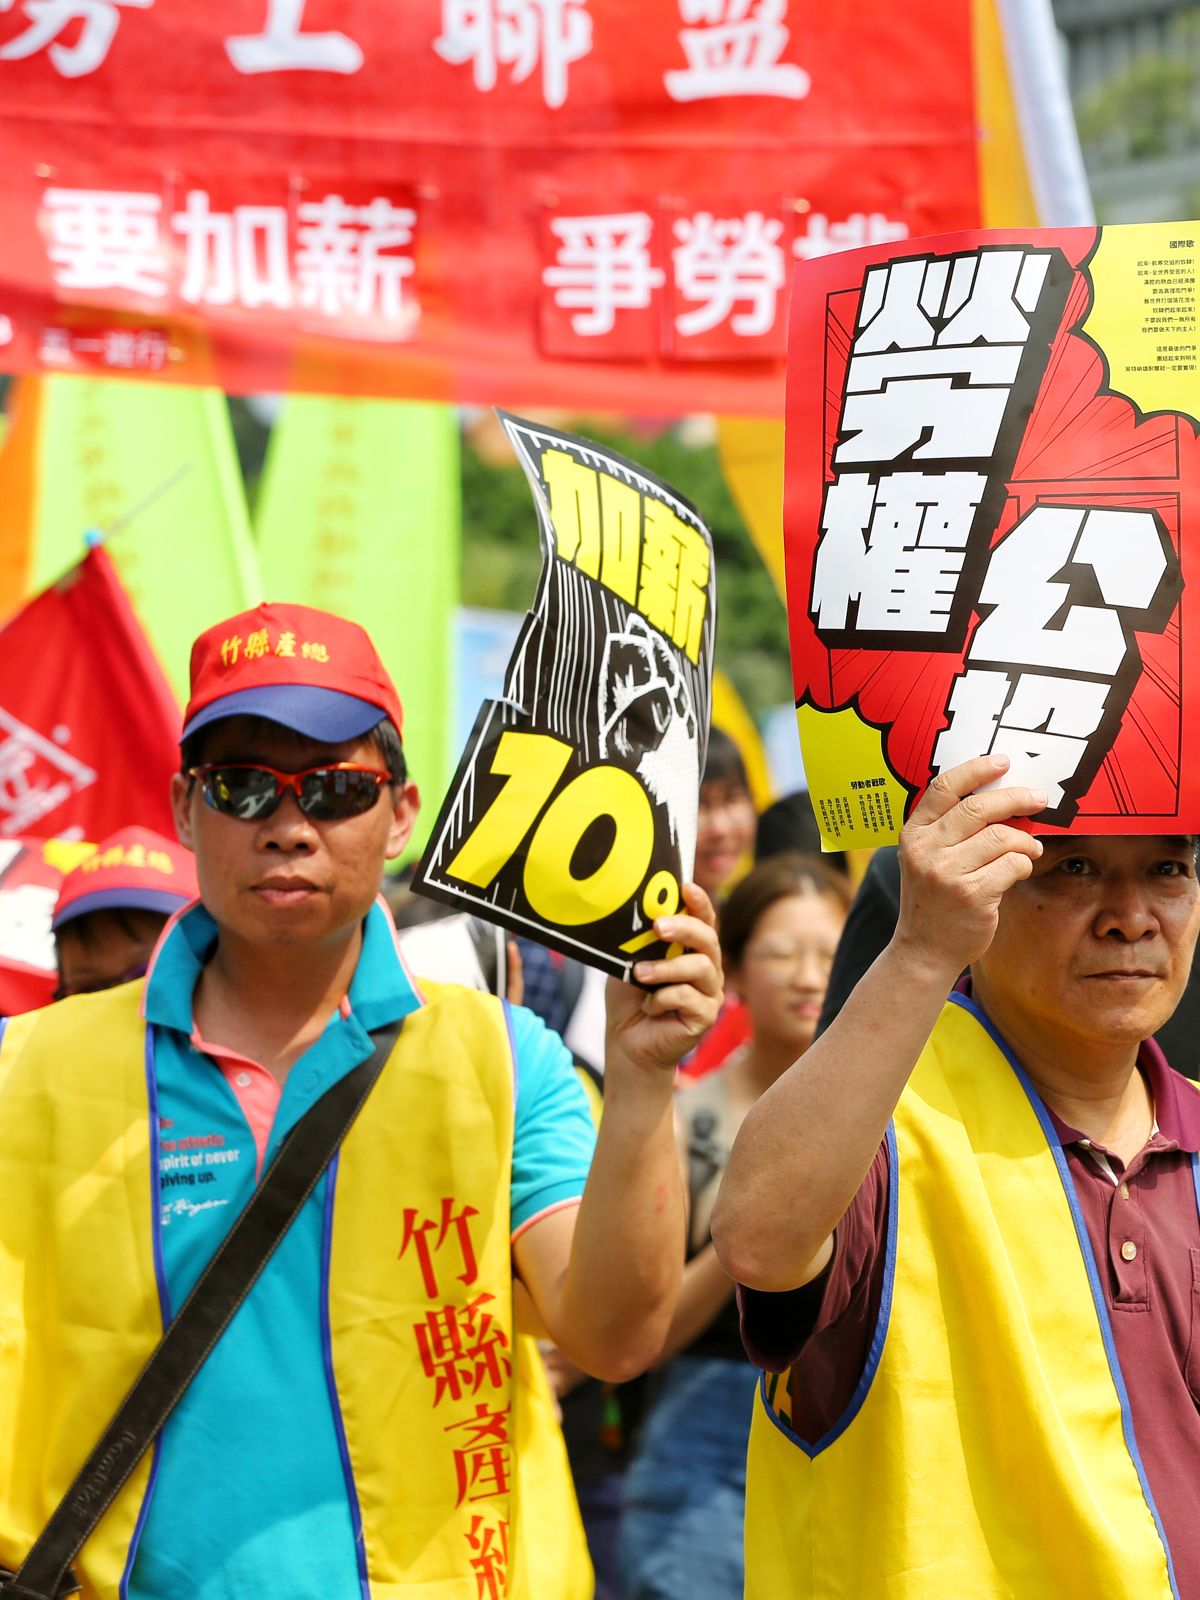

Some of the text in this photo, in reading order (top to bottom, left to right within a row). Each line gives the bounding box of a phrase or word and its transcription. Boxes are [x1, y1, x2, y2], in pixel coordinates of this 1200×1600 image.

[42, 187, 417, 322] 要加薪
[1169, 239, 1195, 249] 國際歌
[811, 250, 1052, 633] 勞權
[541, 449, 711, 667] 加薪
[931, 507, 1168, 810] 公投
